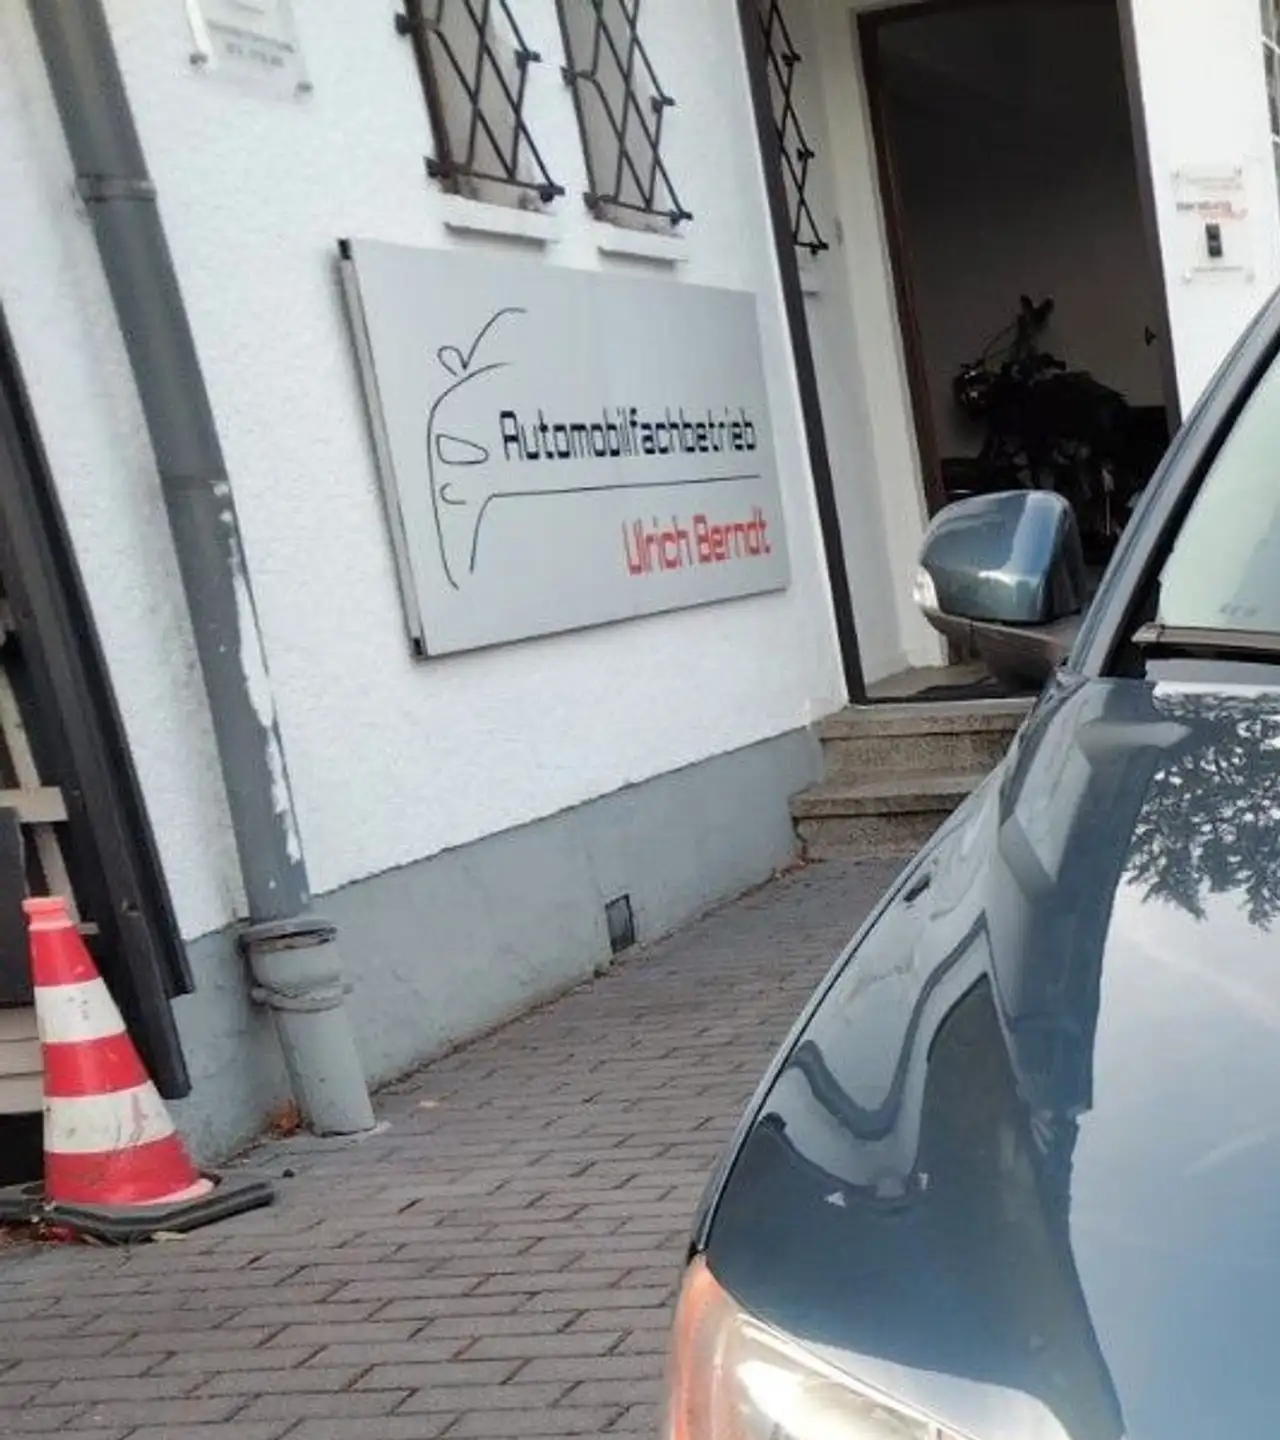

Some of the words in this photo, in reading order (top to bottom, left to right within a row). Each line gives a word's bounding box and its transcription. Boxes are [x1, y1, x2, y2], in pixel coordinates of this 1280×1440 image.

[500, 406, 757, 461] Automobilfachbetrieb
[622, 514, 693, 576] Ulrich
[692, 506, 771, 564] Berndt
